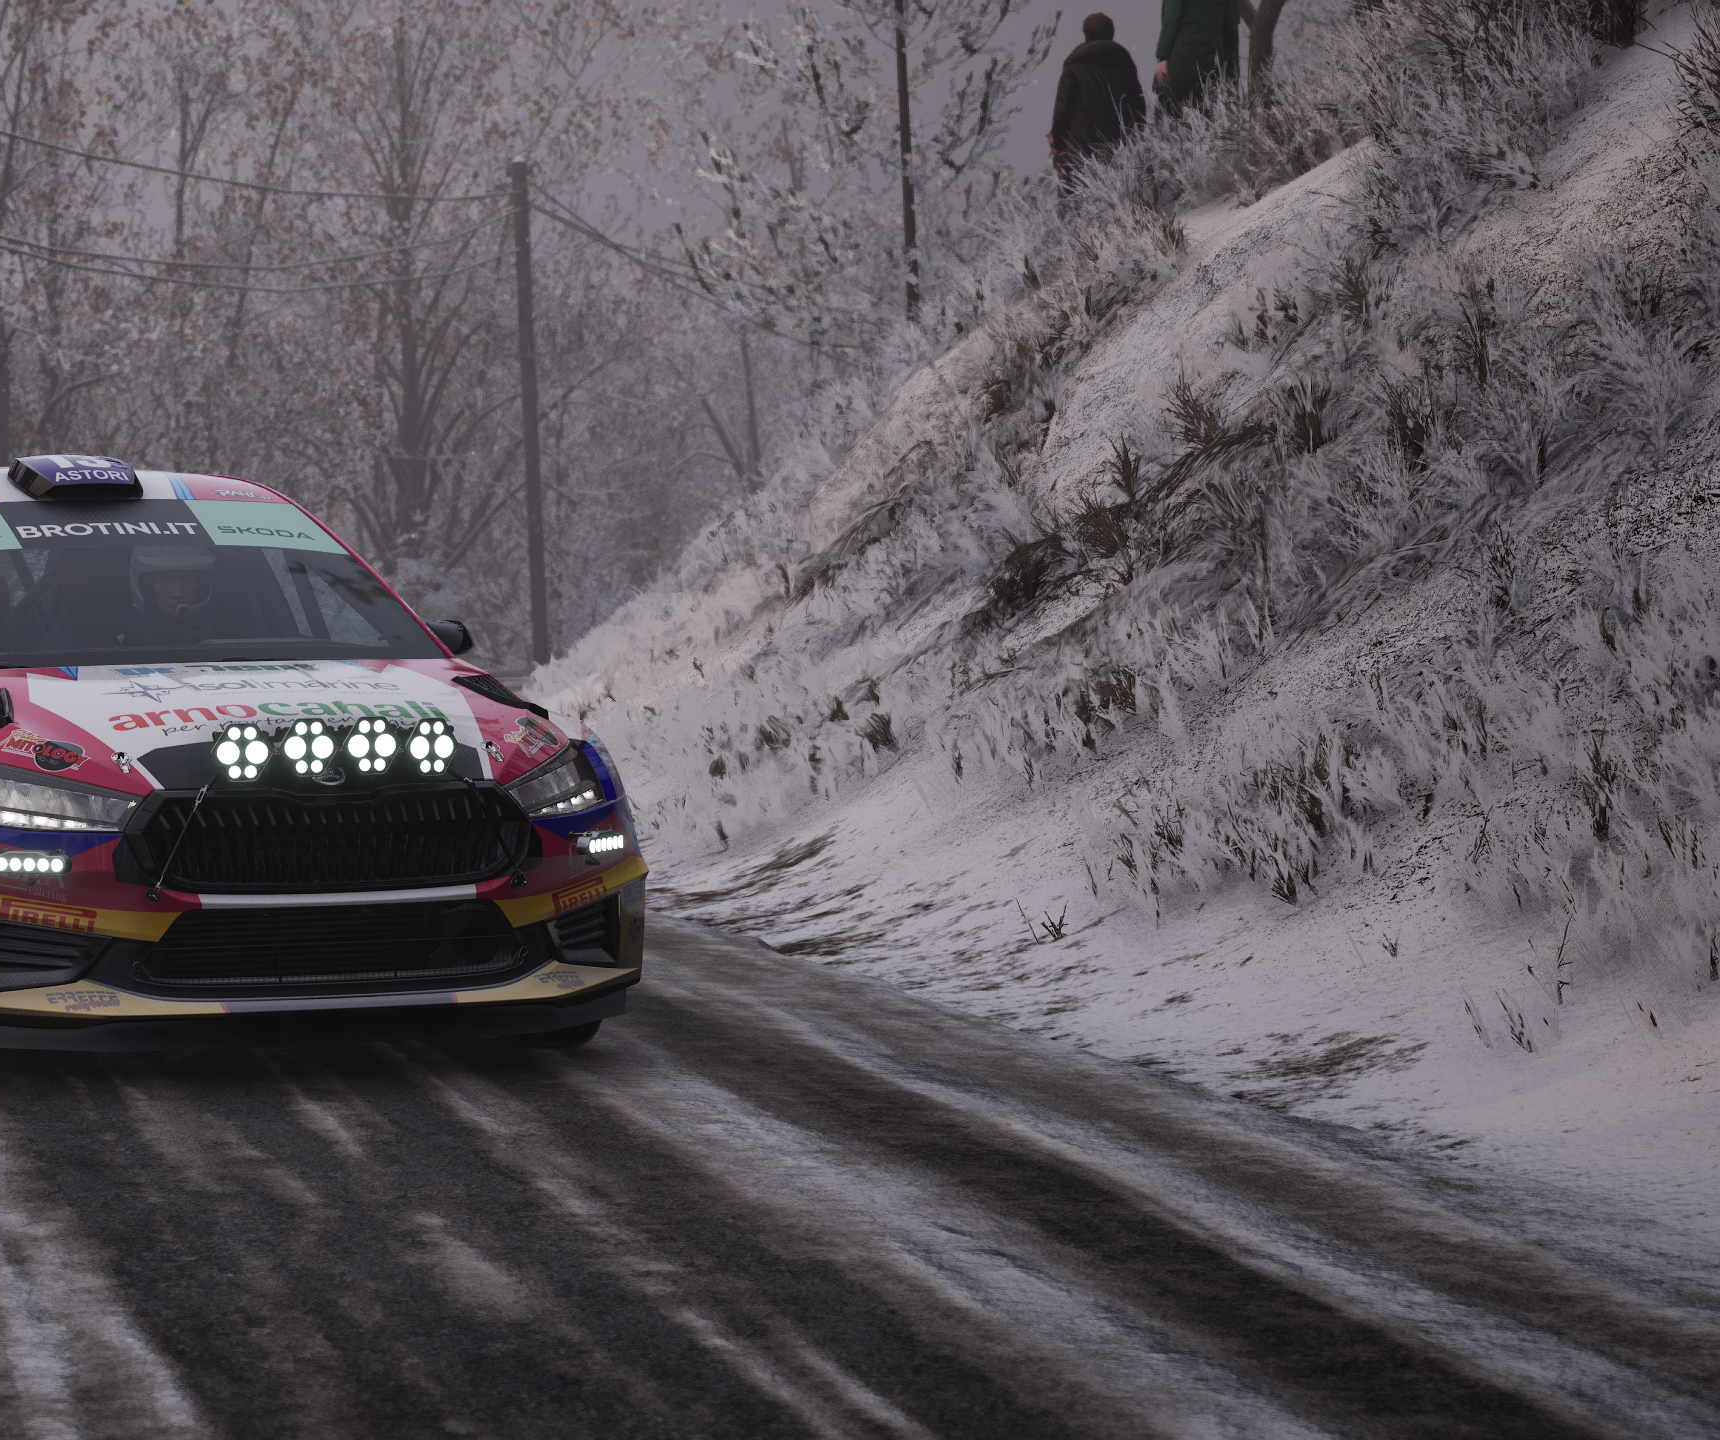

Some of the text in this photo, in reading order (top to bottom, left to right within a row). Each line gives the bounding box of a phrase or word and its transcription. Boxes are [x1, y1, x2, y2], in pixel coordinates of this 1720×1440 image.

[55, 469, 130, 482] ASTORI
[15, 522, 198, 539] BROTINI.IT
[162, 723, 208, 737] per
[4, 737, 89, 766] MITOLOGY
[28, 885, 68, 904] catering
[551, 875, 608, 915] PIRELLI
